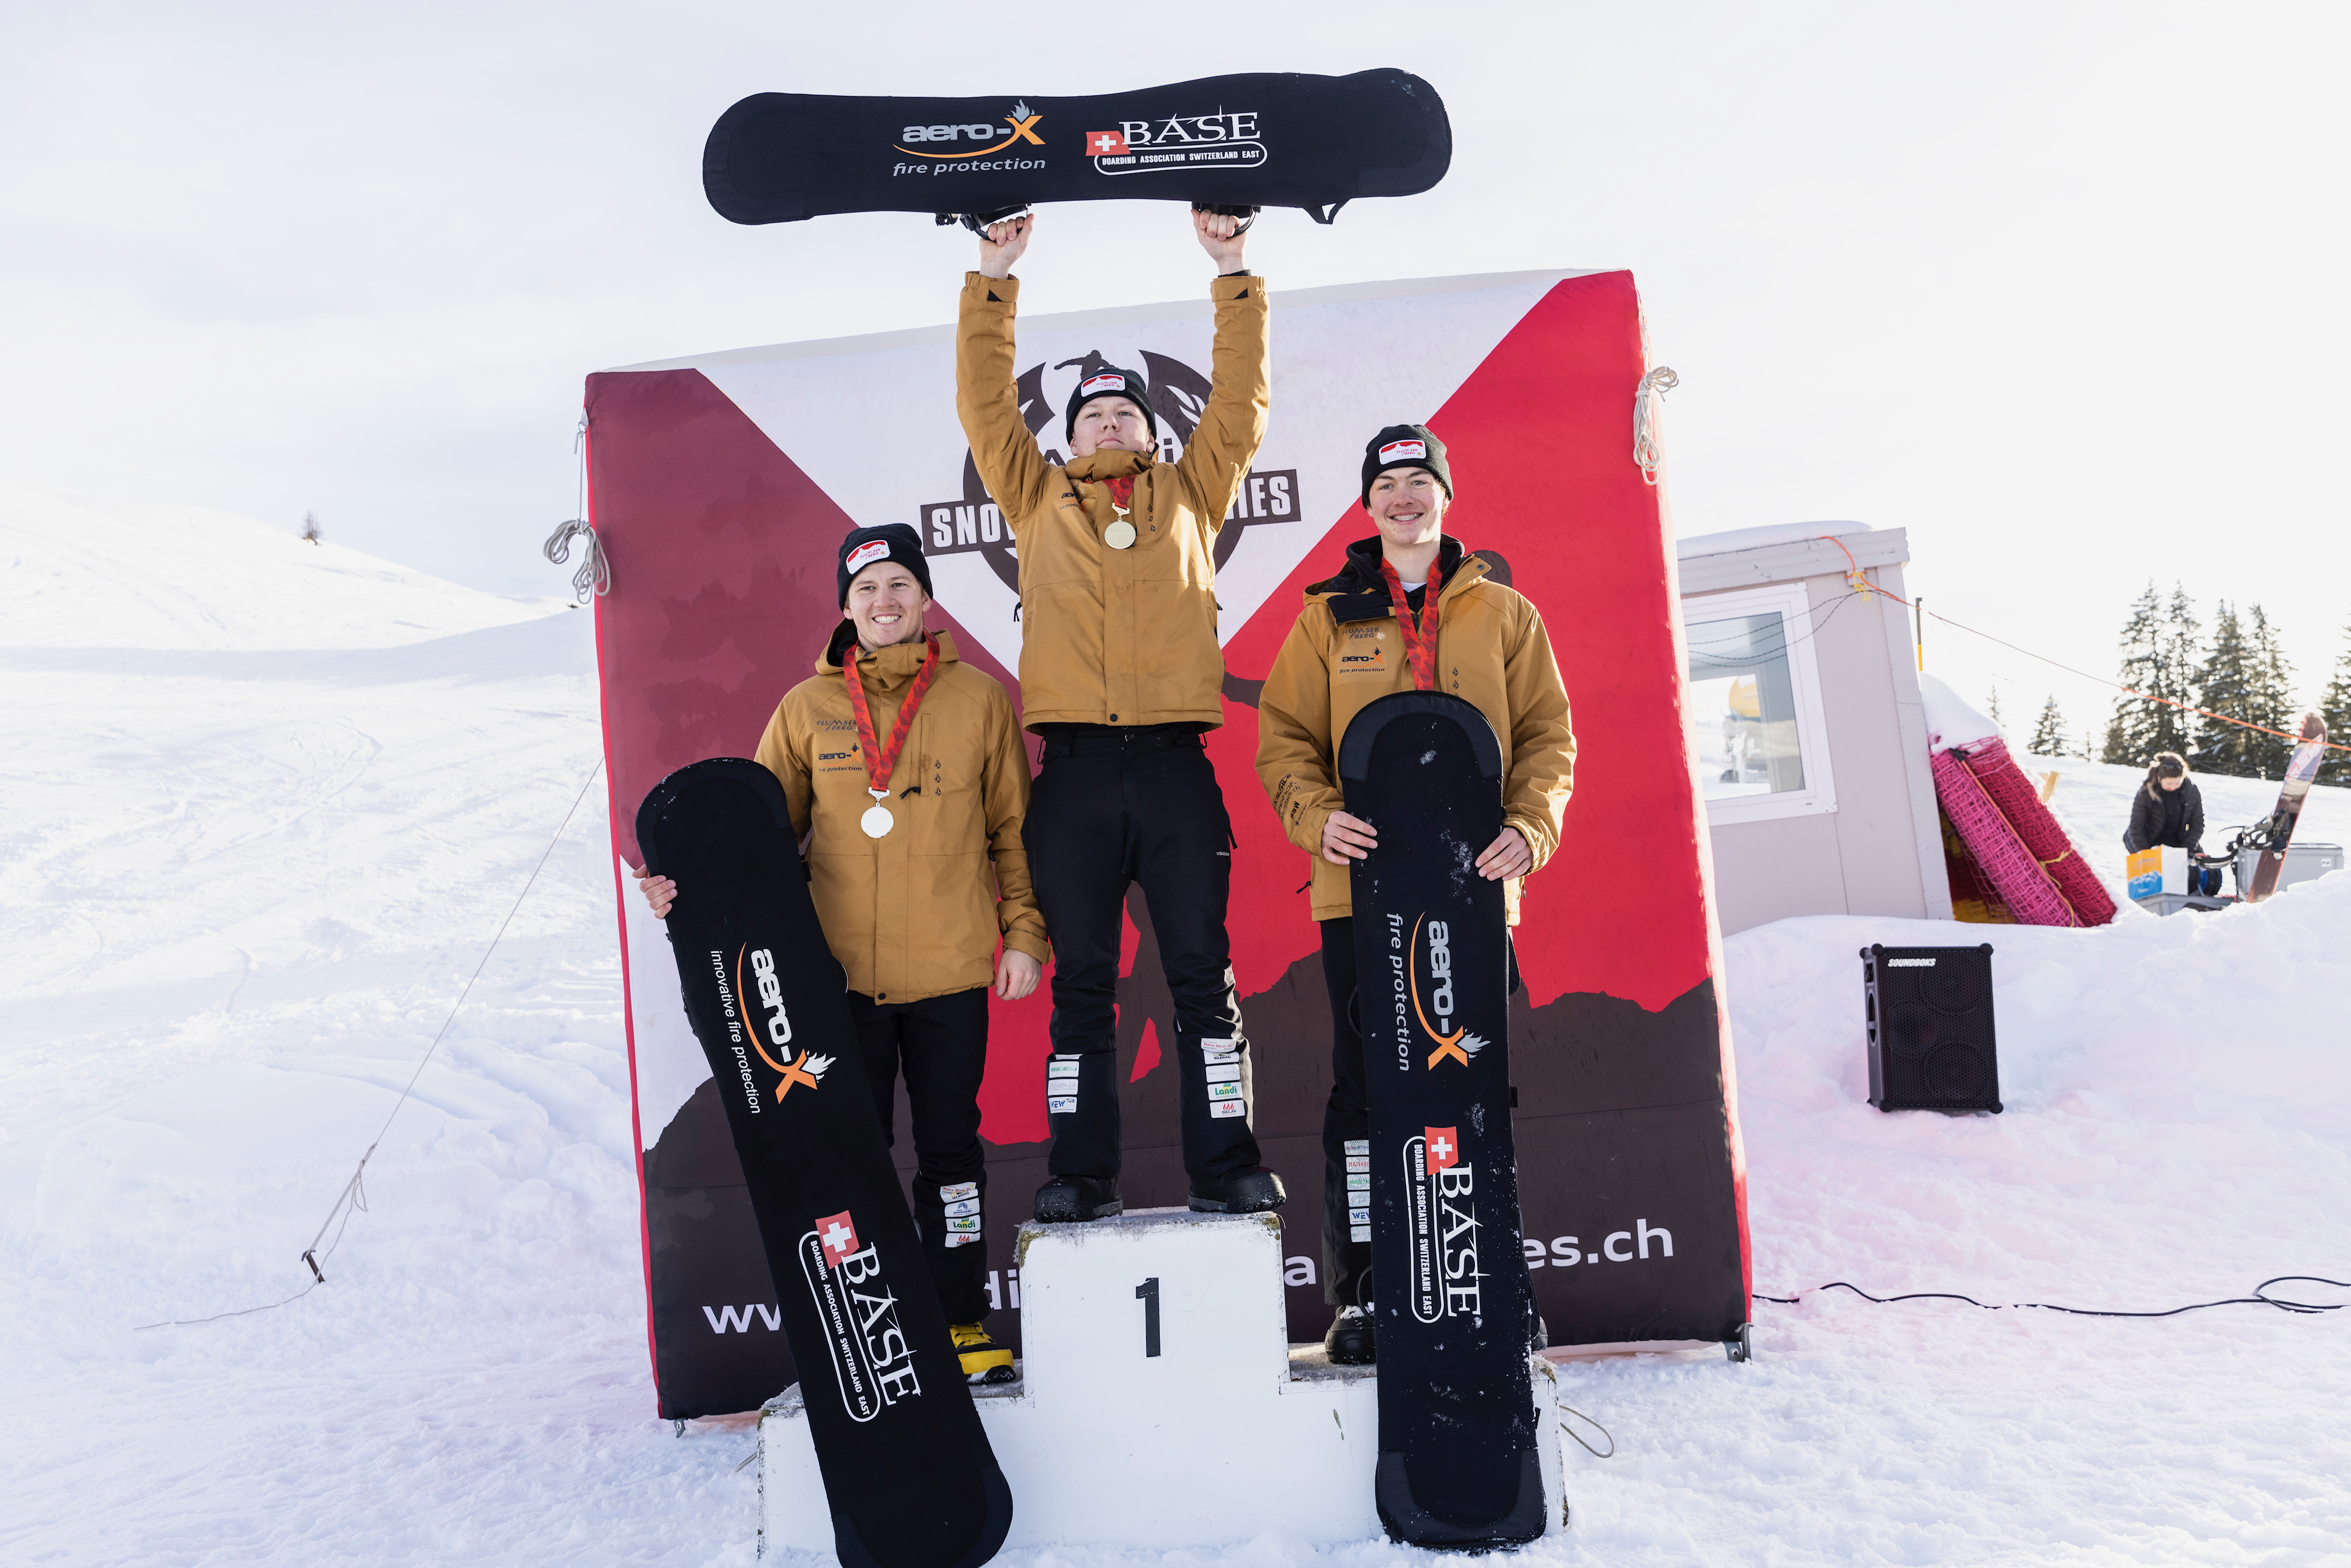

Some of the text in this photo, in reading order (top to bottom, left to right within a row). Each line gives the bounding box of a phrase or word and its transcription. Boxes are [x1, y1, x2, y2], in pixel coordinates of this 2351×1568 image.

[902, 115, 1046, 145] aero-X
[1119, 105, 1260, 145] BASE
[893, 158, 1045, 176] fire protection
[1102, 150, 1260, 165] BOARDING ASSOCIATION SWITZERLAND EAST
[1342, 627, 1379, 639] FLUMSER
[1342, 653, 1384, 664] aero-X
[819, 749, 862, 762] aero-X
[1281, 786, 1301, 823] alenstadt.ch
[1887, 958, 1937, 967] SOUNDBOKS
[1386, 913, 1411, 1071] fire protection
[1428, 920, 1468, 1071] aero-X
[710, 950, 760, 1114] innovative fire protection
[751, 949, 817, 1104] aero-X
[1215, 1086, 1237, 1095] Landi
[953, 1220, 976, 1228] Landi
[1414, 1143, 1432, 1315] BOARDING ASSOCIATION SWITZERLAND EAST
[1439, 1162, 1491, 1317] BASE
[810, 1241, 870, 1415] BOARDING ASSOCIATION SWITZERLAND EAST
[841, 1242, 921, 1406] BASE
[1136, 1277, 1161, 1357] 1
